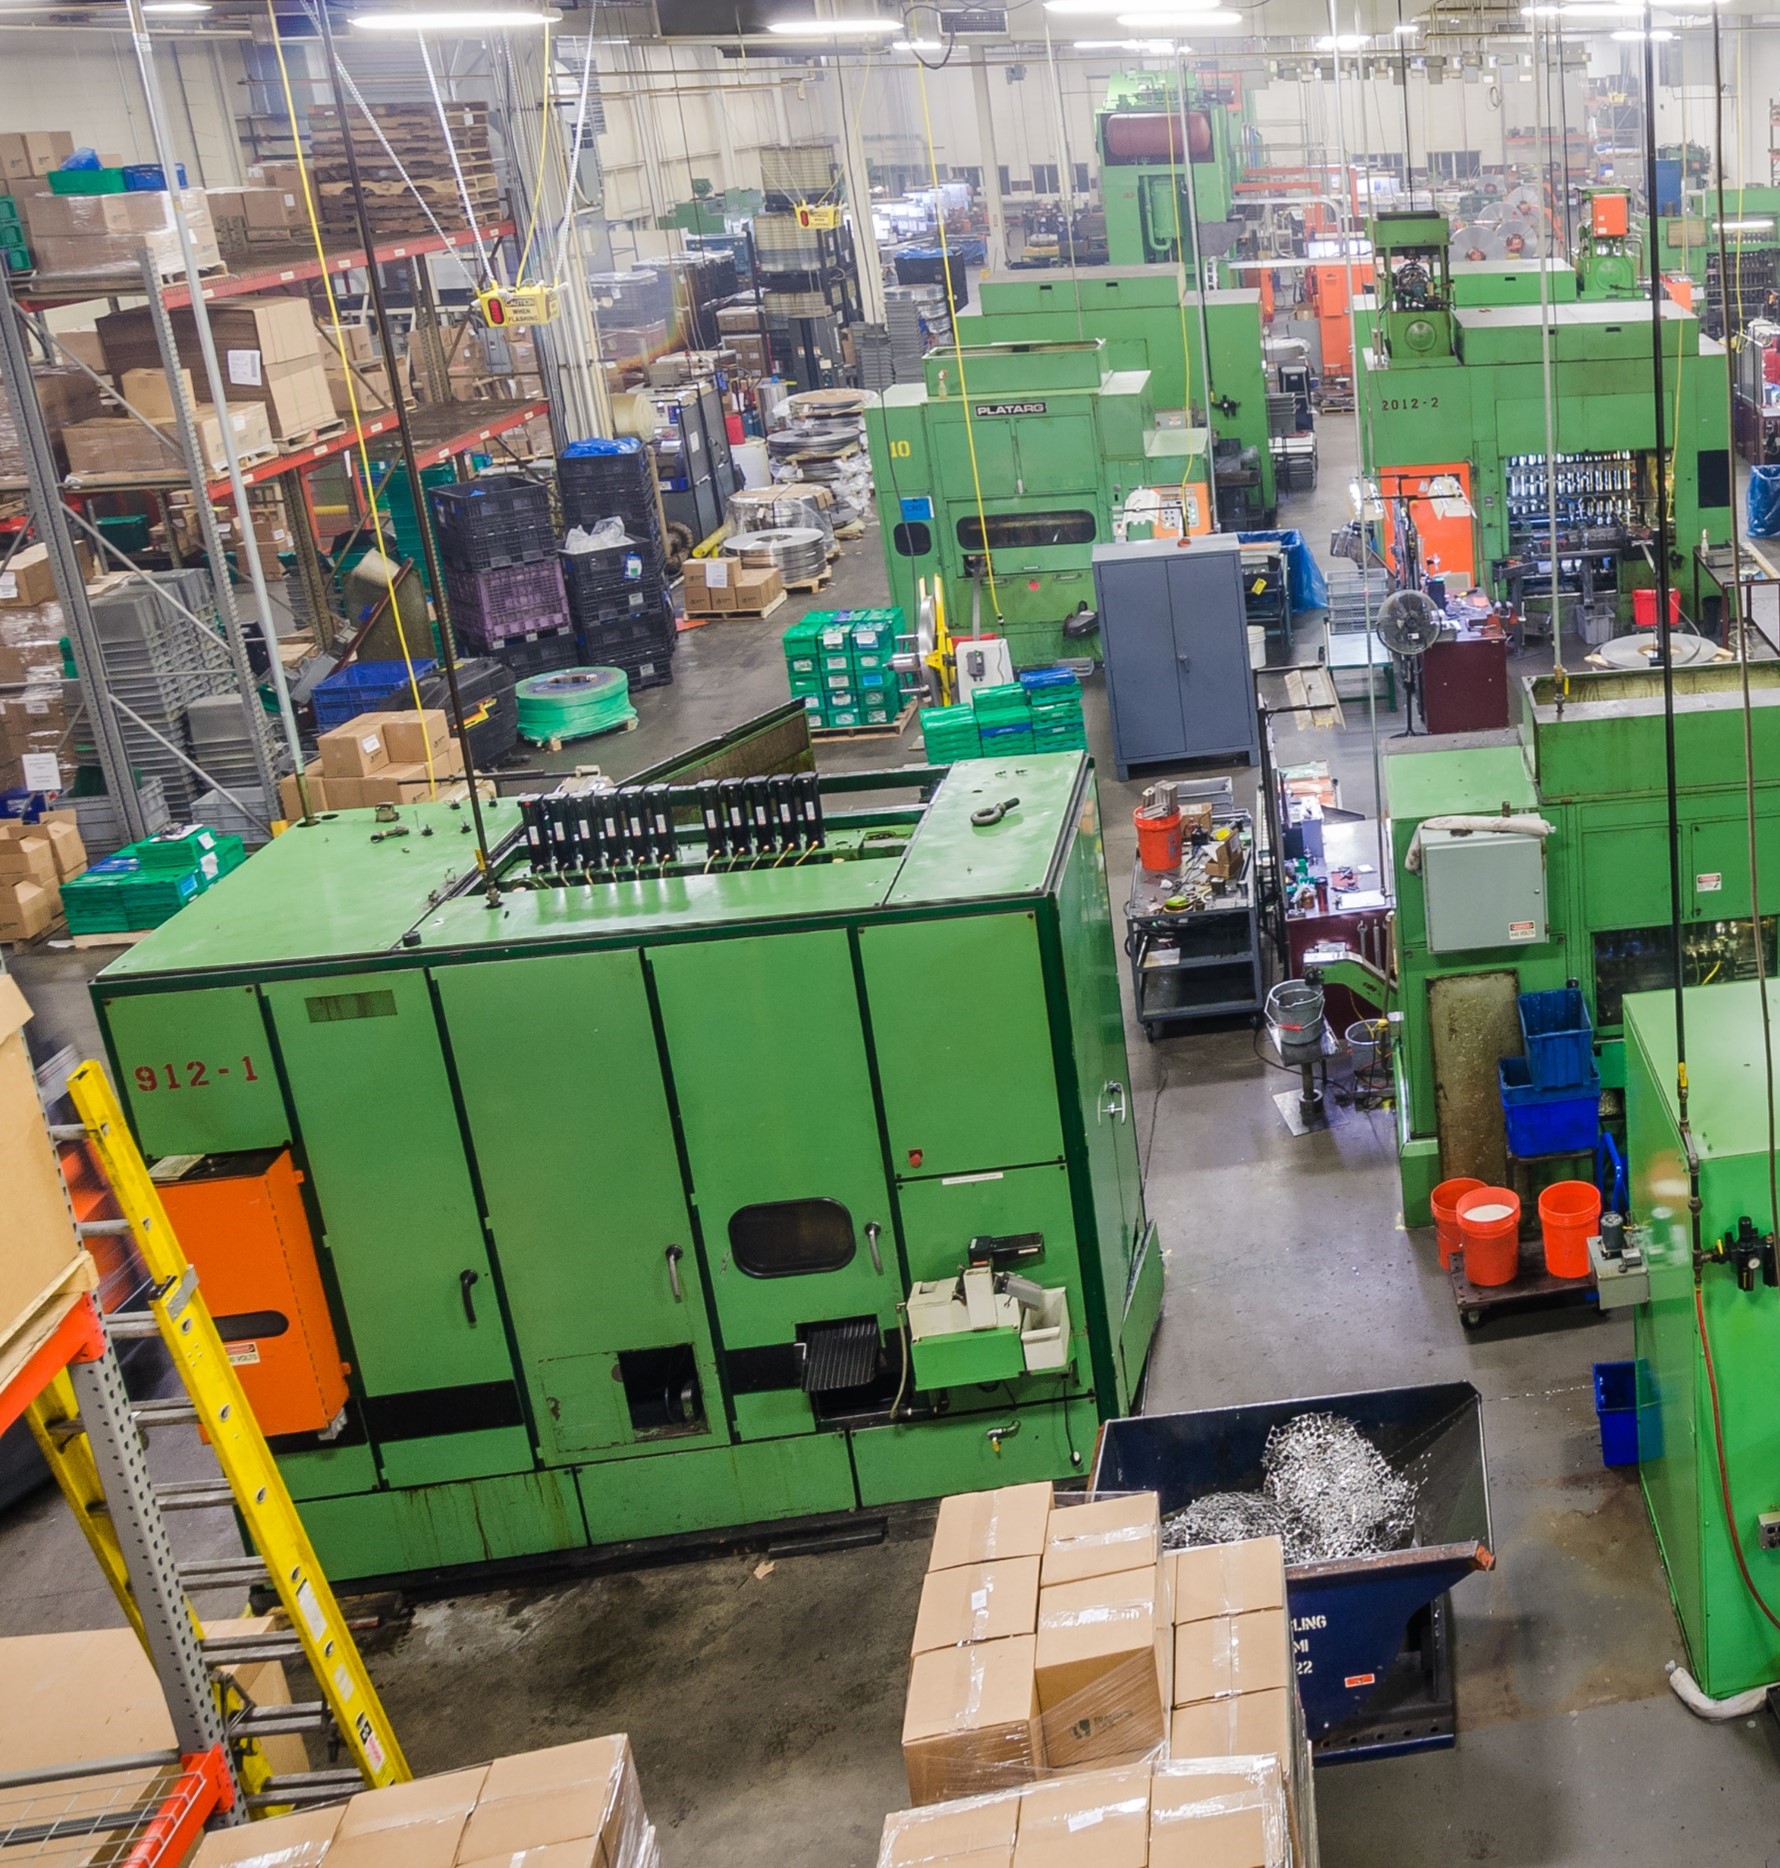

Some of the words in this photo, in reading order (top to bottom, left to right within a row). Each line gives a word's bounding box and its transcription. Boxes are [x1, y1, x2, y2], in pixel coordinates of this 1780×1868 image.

[976, 403, 1045, 416] PLATARG
[1381, 396, 1439, 411] 2012-2
[889, 440, 911, 458] 10
[134, 1055, 258, 1092] 912-1
[1290, 1615, 1327, 1631] LING
